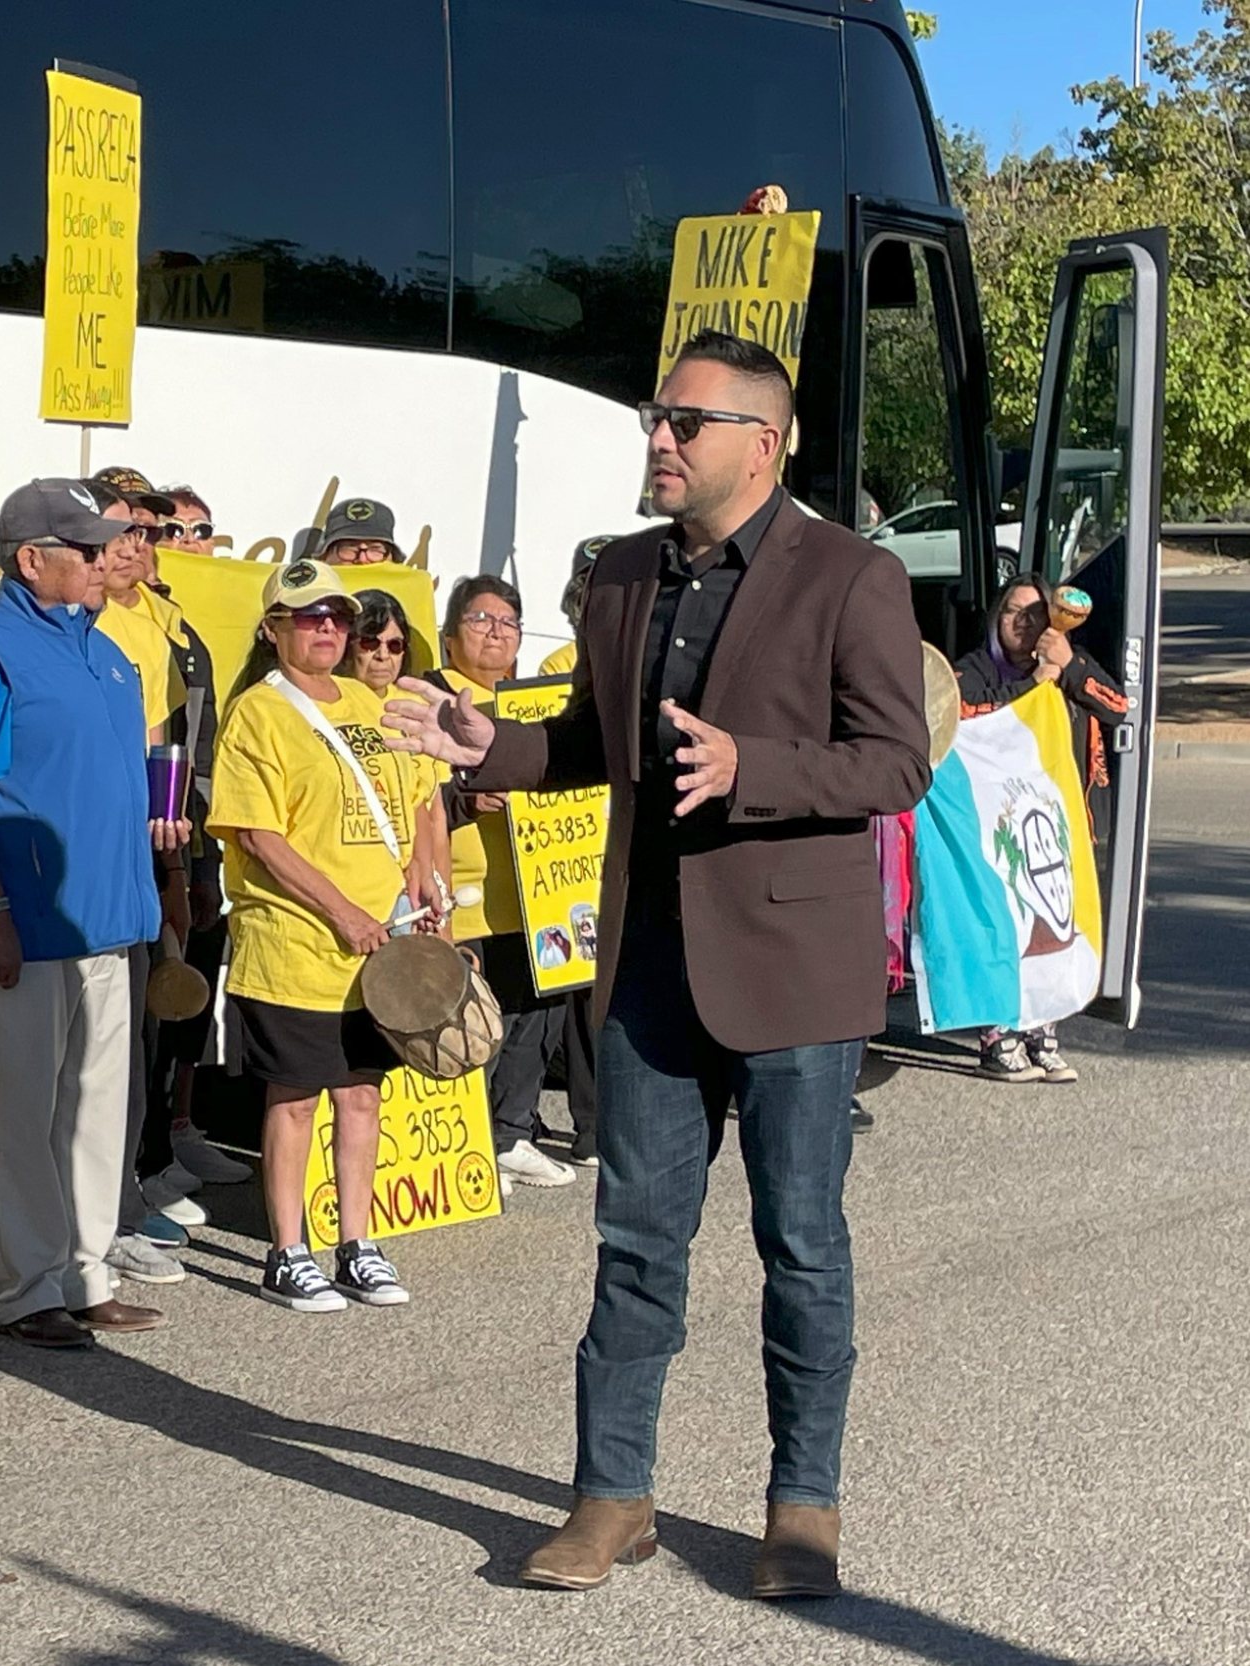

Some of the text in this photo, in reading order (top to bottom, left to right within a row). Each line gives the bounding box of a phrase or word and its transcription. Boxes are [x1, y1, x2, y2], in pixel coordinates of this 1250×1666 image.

[54, 95, 137, 192] PASS RECA
[63, 192, 98, 240] Before
[63, 244, 123, 312] People Like
[694, 225, 777, 289] MIKE
[76, 312, 107, 369] ME
[507, 700, 555, 720] Speaker
[345, 797, 401, 817] BERE
[533, 854, 604, 899] A PRIORIT
[369, 1162, 452, 1235] NOW!
